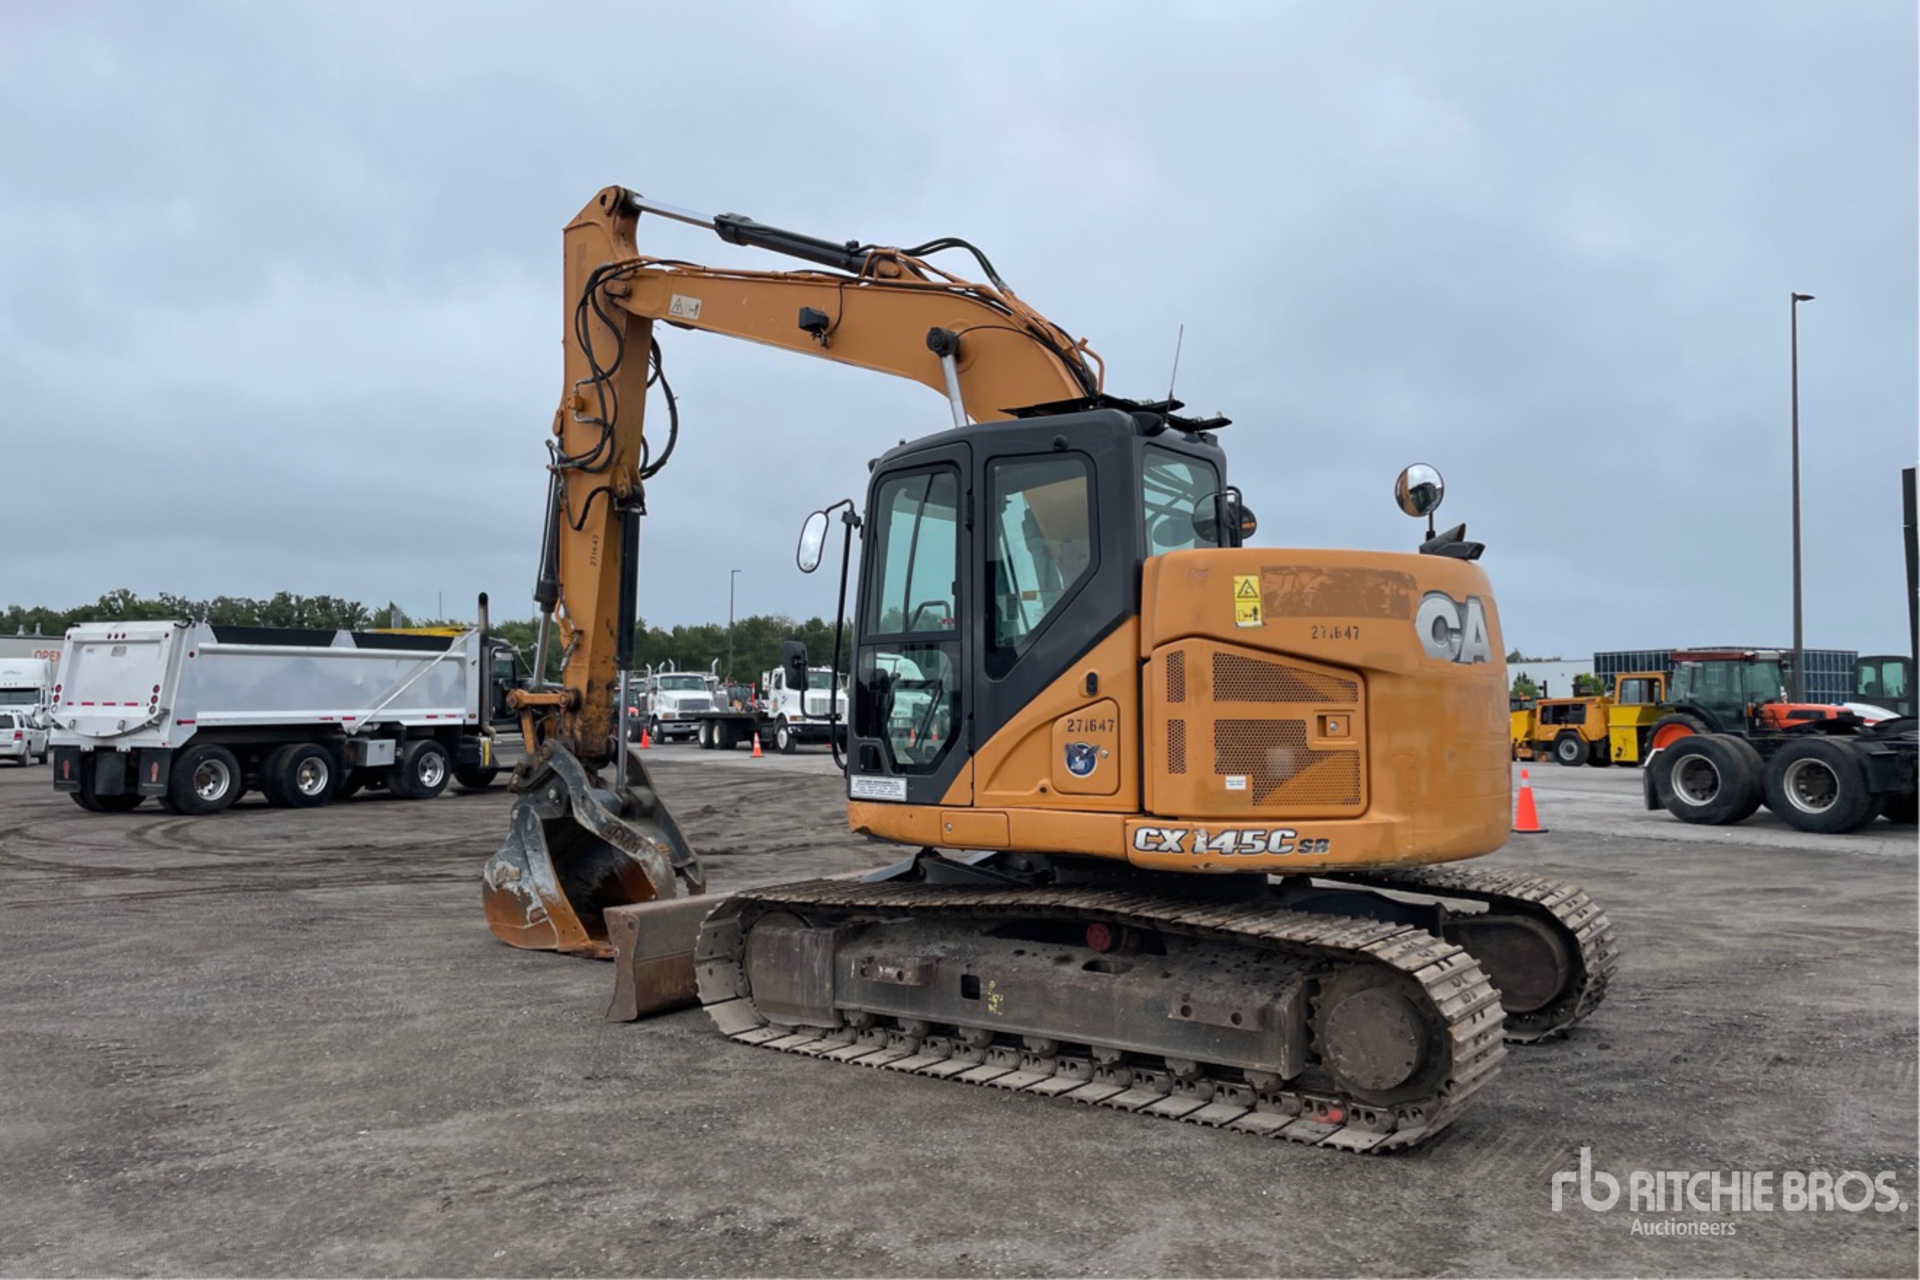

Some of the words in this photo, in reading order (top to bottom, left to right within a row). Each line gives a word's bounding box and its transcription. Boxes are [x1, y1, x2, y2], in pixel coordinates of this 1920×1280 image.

[1311, 624, 1360, 640] 271647
[1067, 718, 1116, 733] 271647
[1297, 837, 1331, 855] SR
